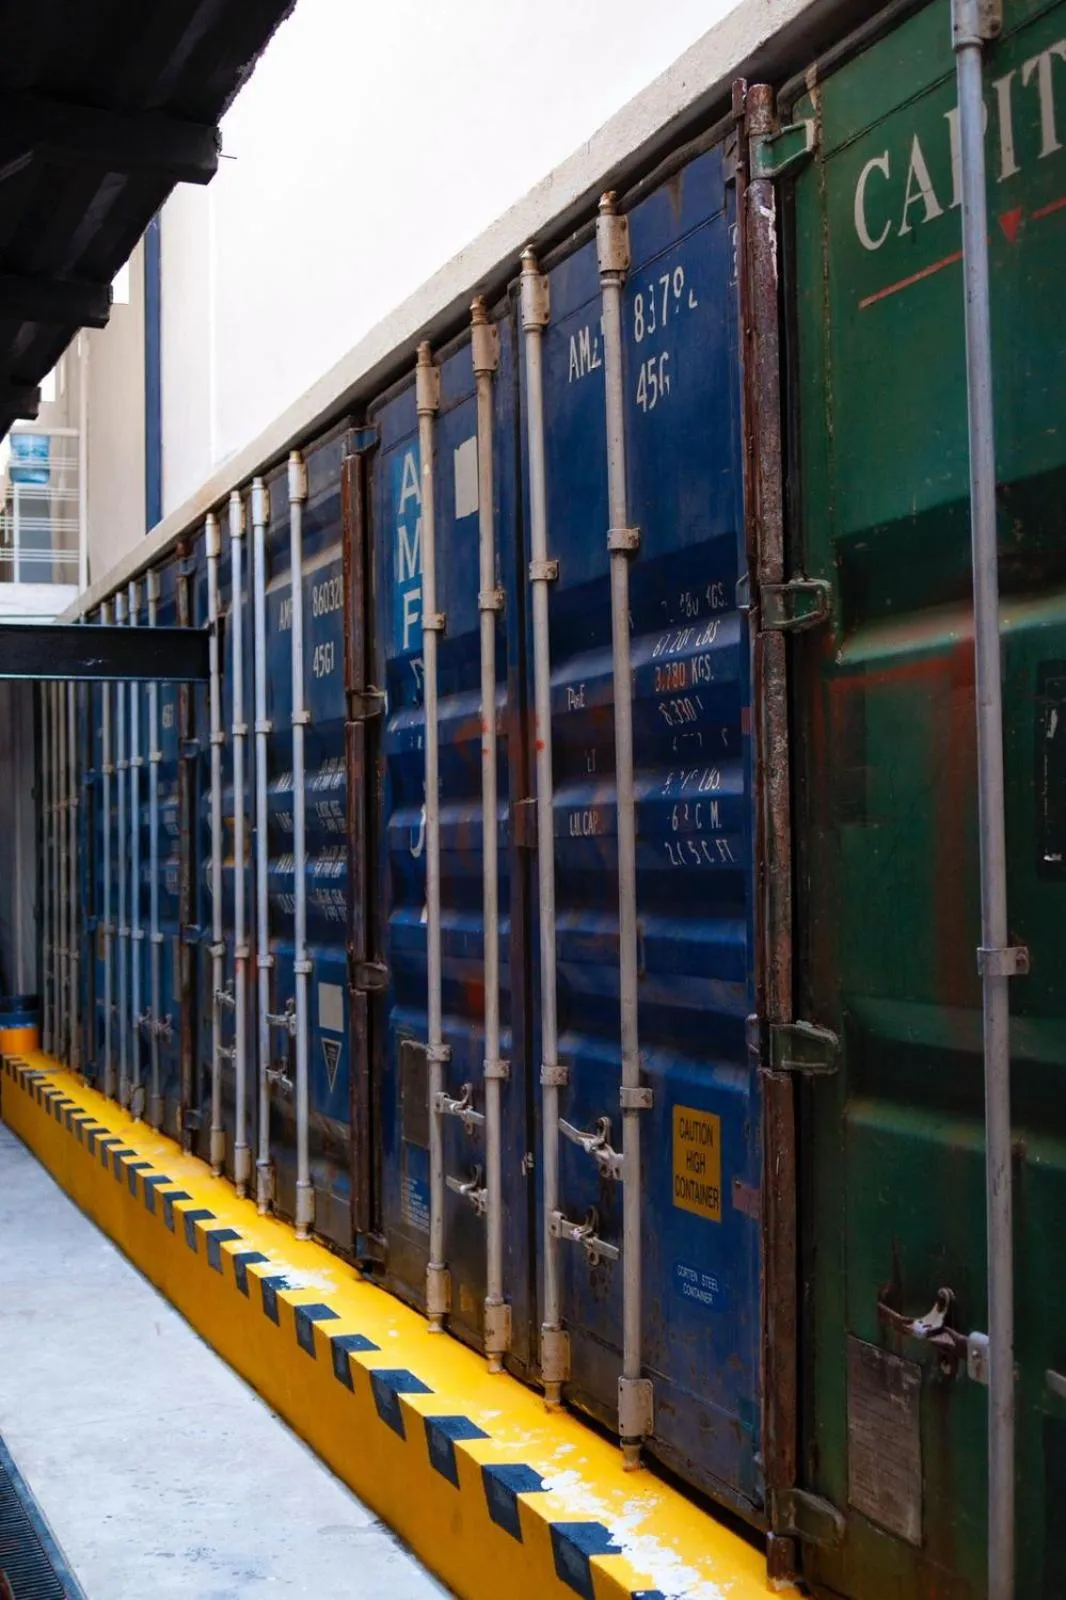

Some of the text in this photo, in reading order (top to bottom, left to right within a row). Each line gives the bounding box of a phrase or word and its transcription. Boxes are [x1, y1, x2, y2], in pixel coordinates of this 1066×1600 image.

[679, 1117, 714, 1149] CAUTION
[686, 1151, 706, 1175] HIGH
[674, 1174, 719, 1213] CONTAINER
